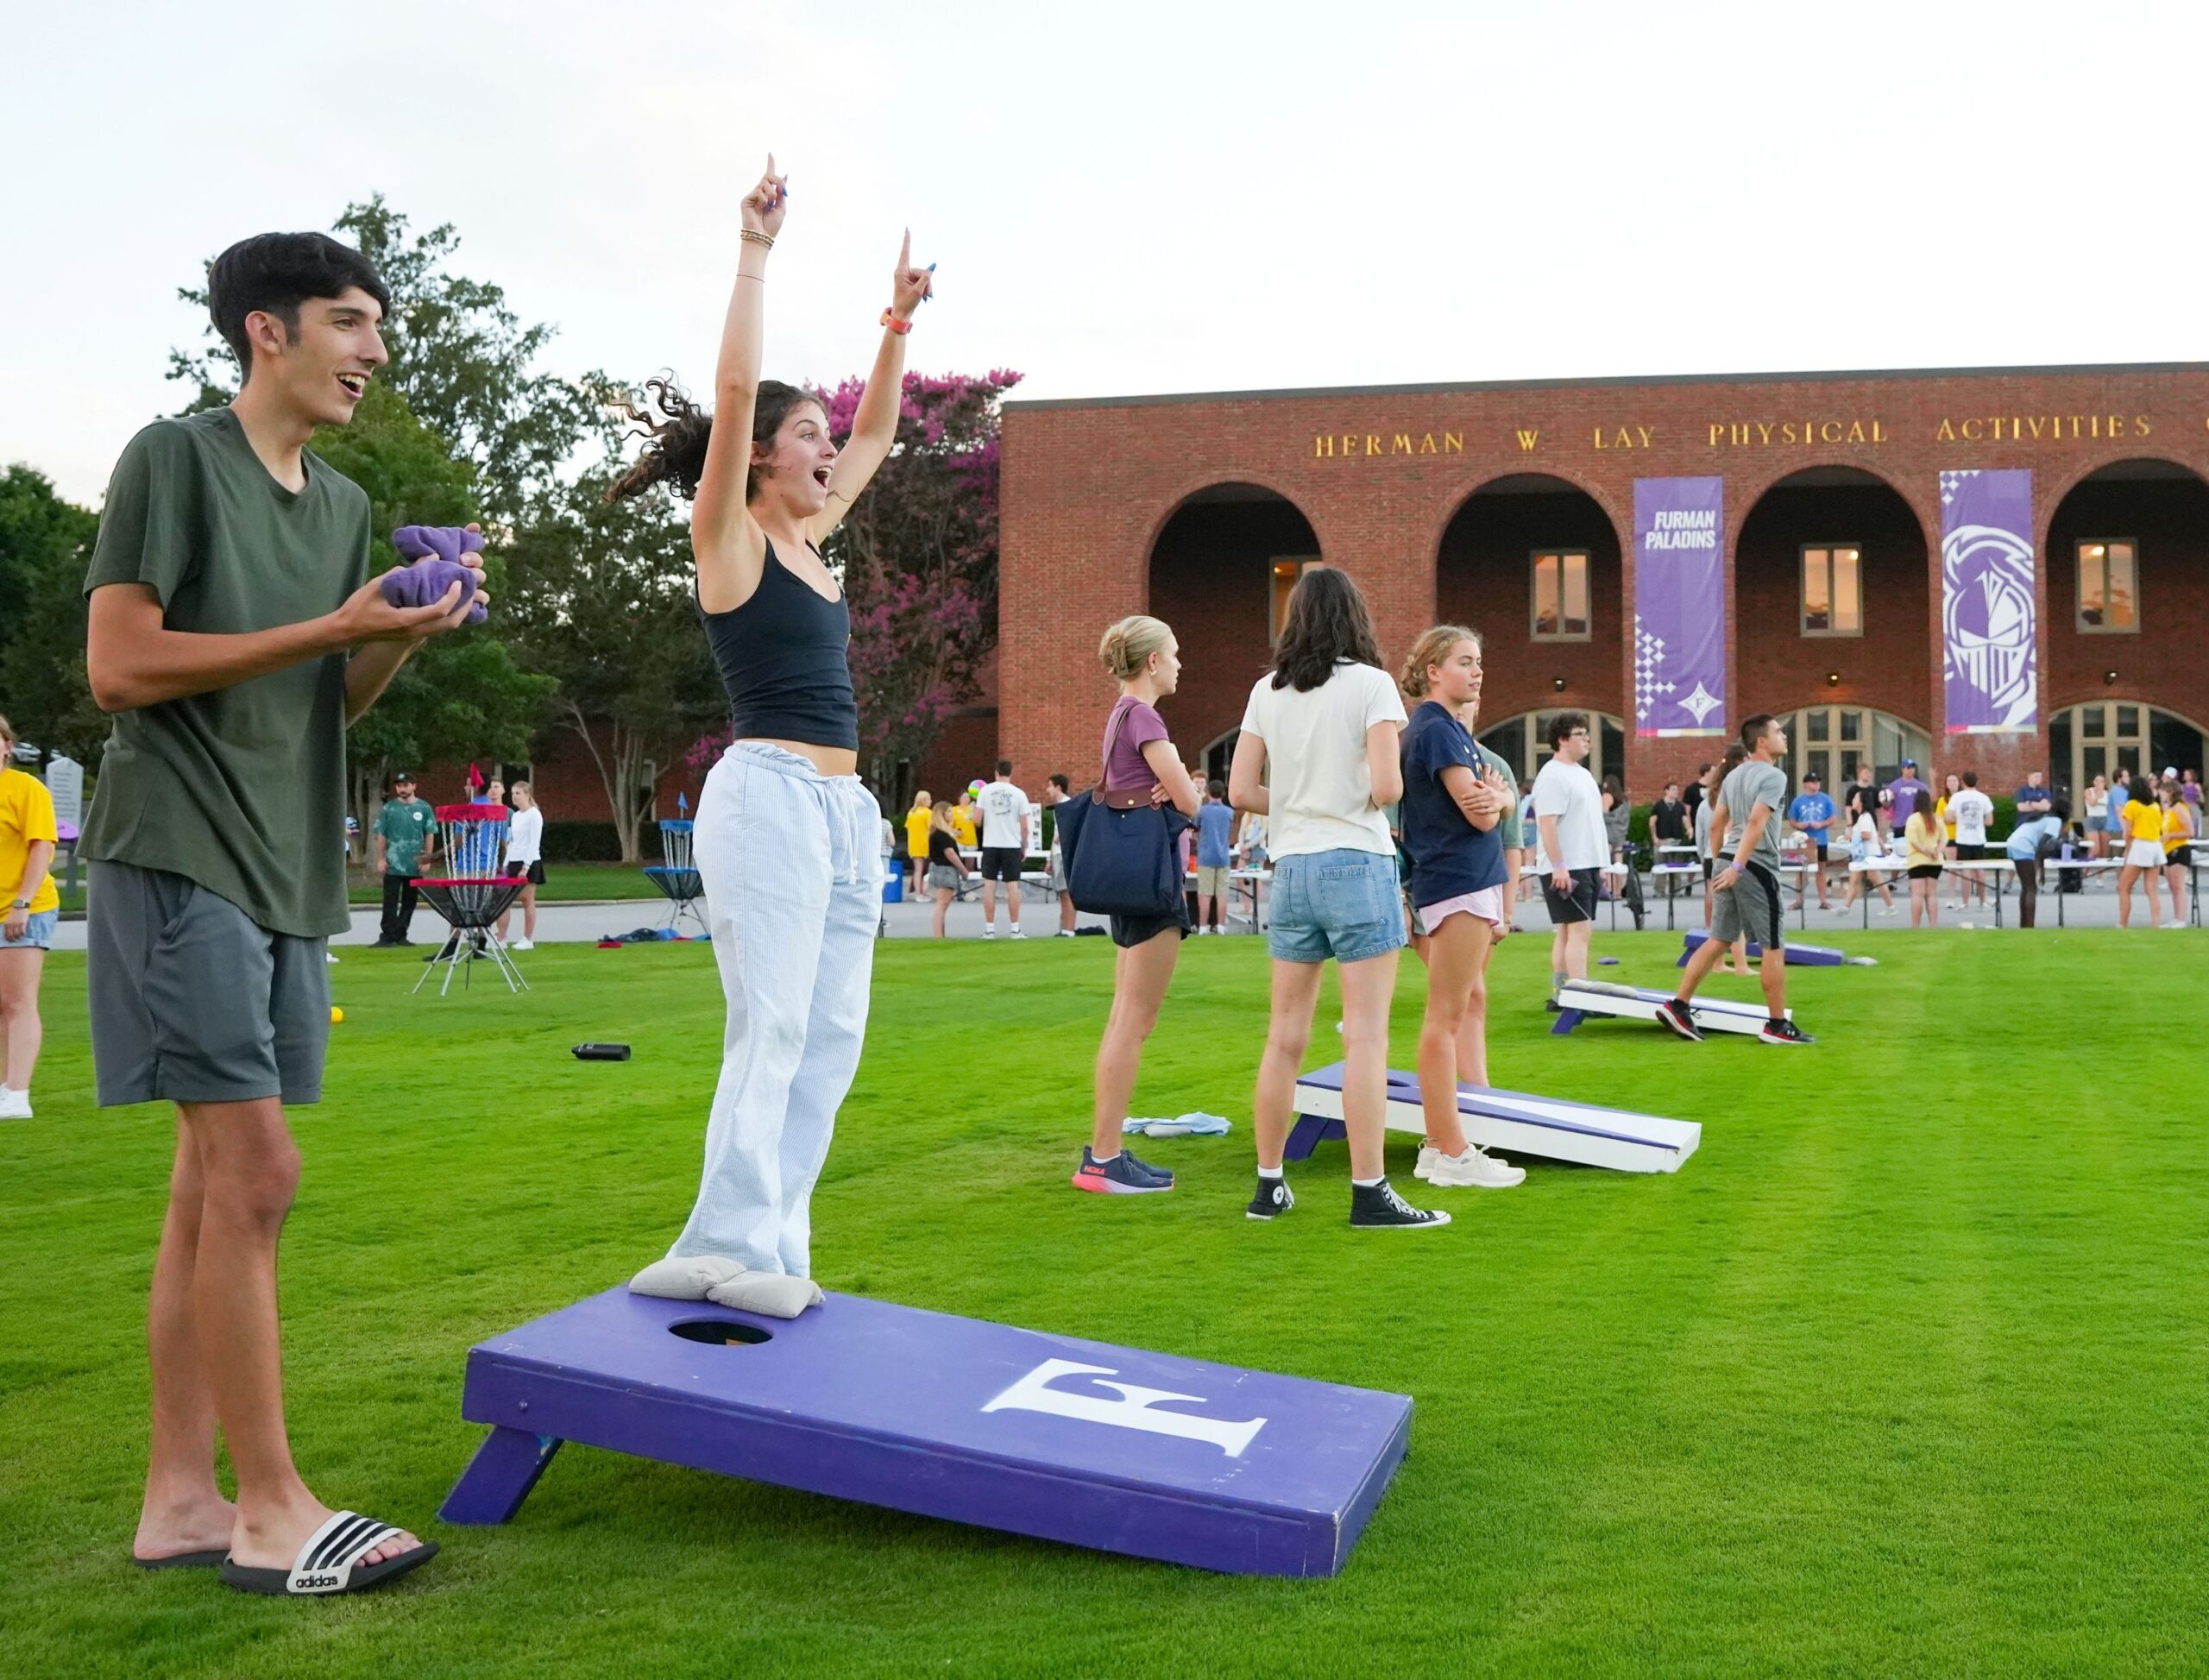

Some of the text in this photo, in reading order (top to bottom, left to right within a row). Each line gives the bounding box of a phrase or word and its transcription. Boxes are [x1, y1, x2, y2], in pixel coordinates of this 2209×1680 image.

[1315, 415, 2150, 457] HERMAN W LAY PHYSICAL ACTIVITIES
[1654, 510, 1715, 531] FURMAN
[1645, 530, 1716, 550] PALADINS
[1696, 697, 1705, 708] F
[1084, 1165, 1105, 1175] HOKA
[980, 1357, 1268, 1457] F
[296, 1575, 338, 1588] adidas
